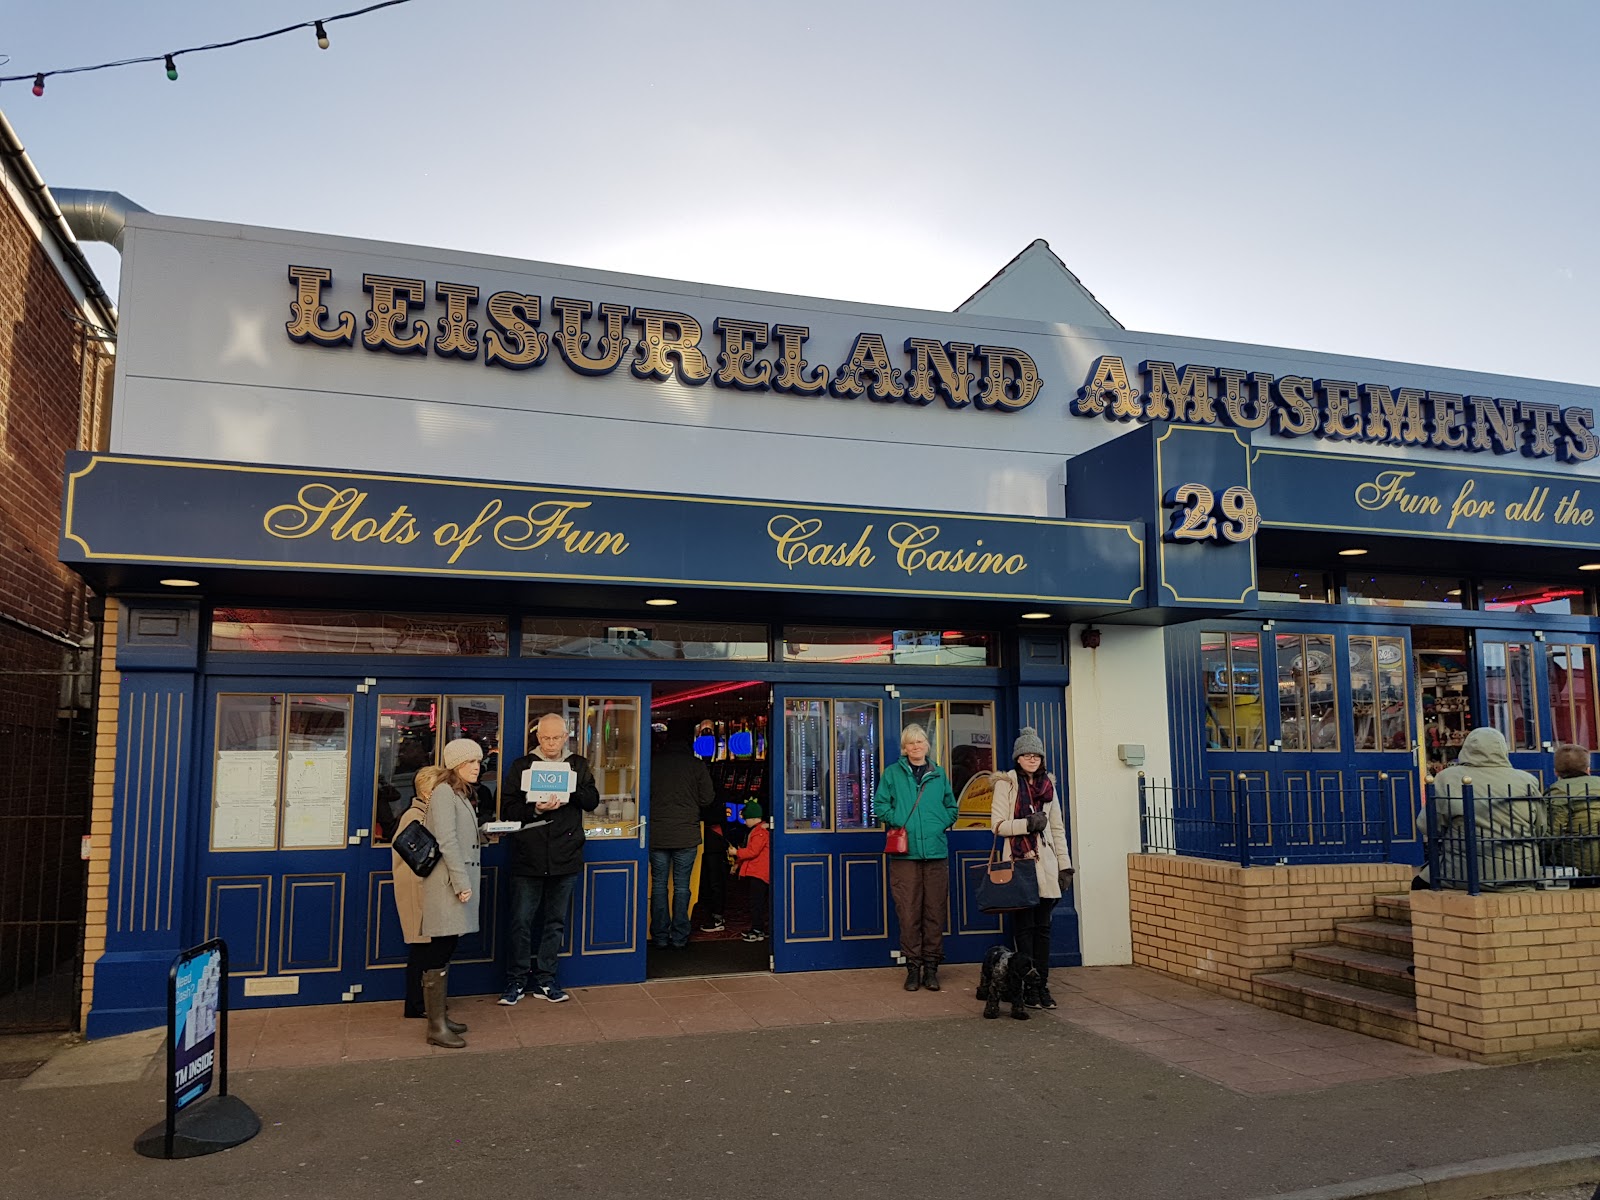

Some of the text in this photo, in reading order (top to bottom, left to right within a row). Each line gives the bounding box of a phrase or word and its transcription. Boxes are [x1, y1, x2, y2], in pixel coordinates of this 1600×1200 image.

[286, 264, 1599, 462] LEISURELAND AMUSEMENTS
[263, 484, 629, 563] Slots of Fun
[1162, 483, 1261, 544] 29
[1355, 470, 1596, 528] Fun for all the
[767, 513, 1027, 576] Cash Casino
[175, 1065, 188, 1088] TM
[188, 1049, 214, 1080] INSIDE
